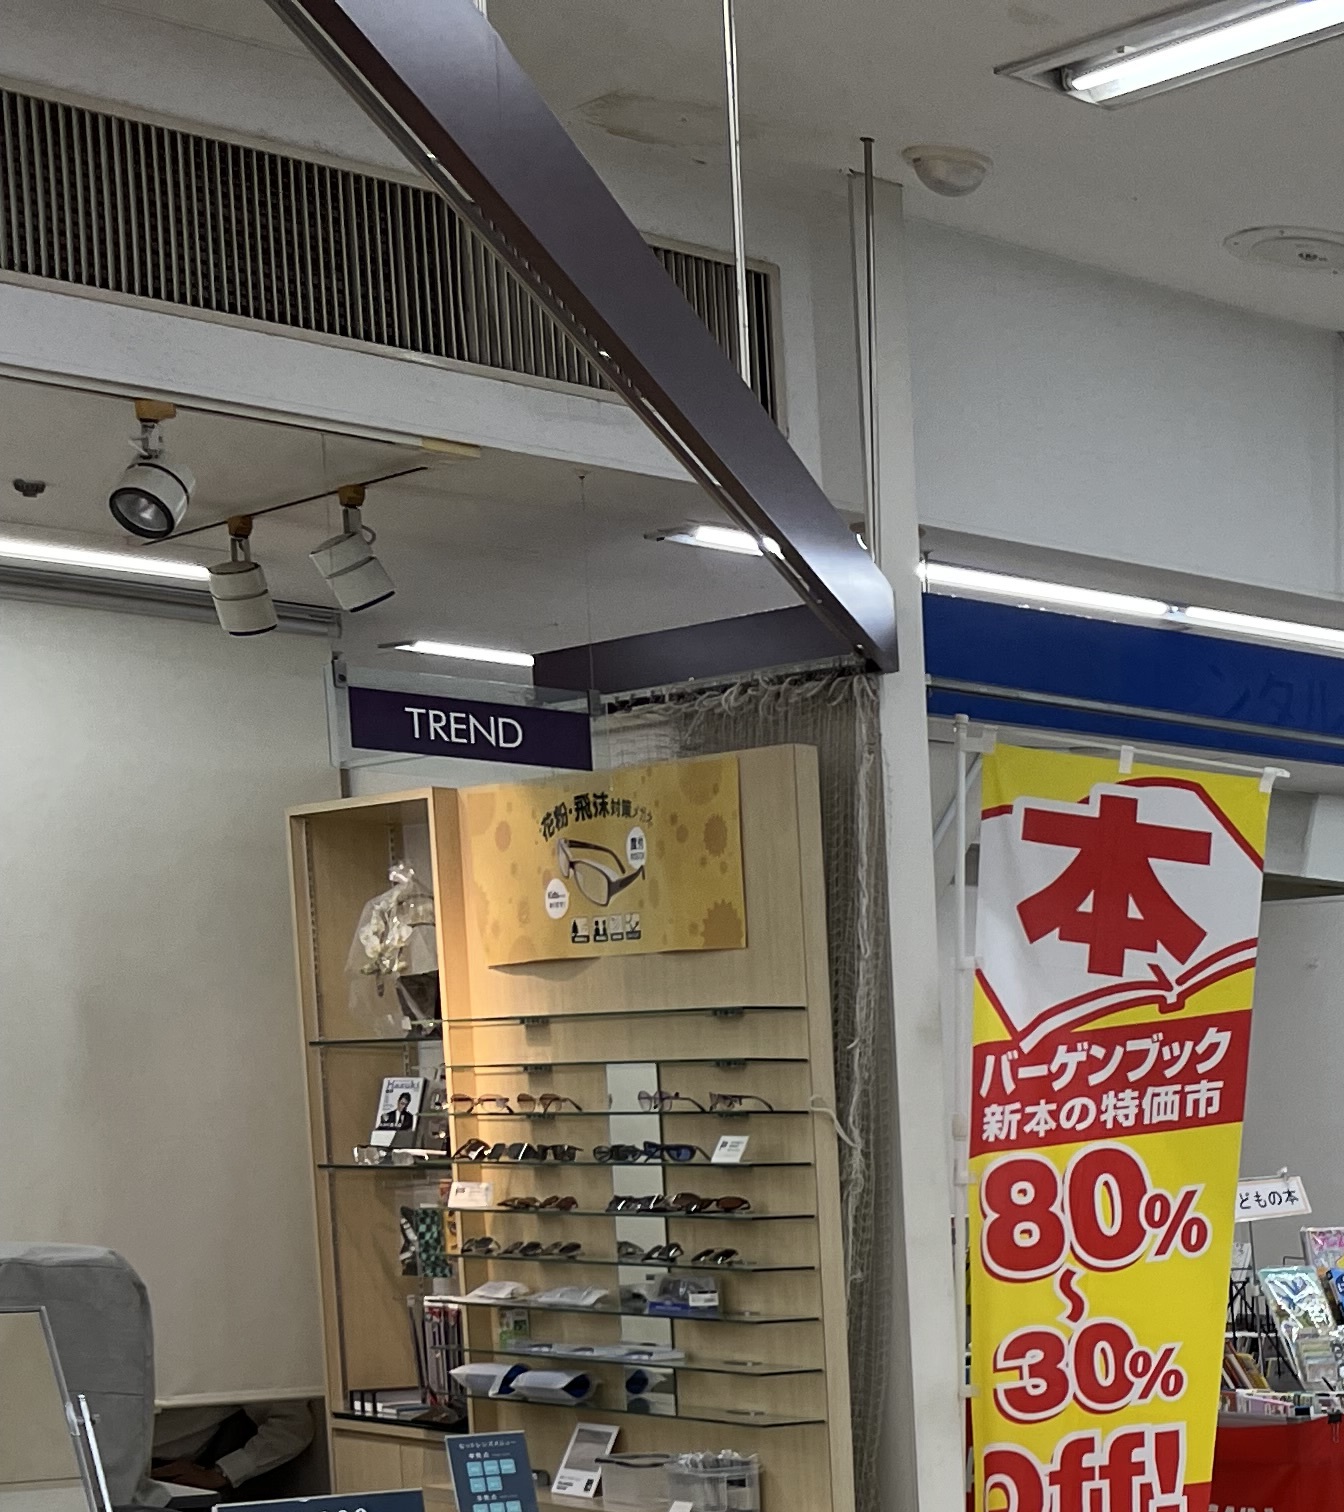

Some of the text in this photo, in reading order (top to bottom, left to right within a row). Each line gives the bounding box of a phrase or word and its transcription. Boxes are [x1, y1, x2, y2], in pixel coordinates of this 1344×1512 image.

[405, 707, 524, 749] TREND
[1017, 794, 1212, 977] 本
[980, 1027, 1232, 1098] バーゲンブック
[982, 1079, 1224, 1142] 新本の特価市
[981, 1143, 1210, 1282] 80%
[1239, 1188, 1299, 1210] どもの本
[993, 1318, 1187, 1423] 30%
